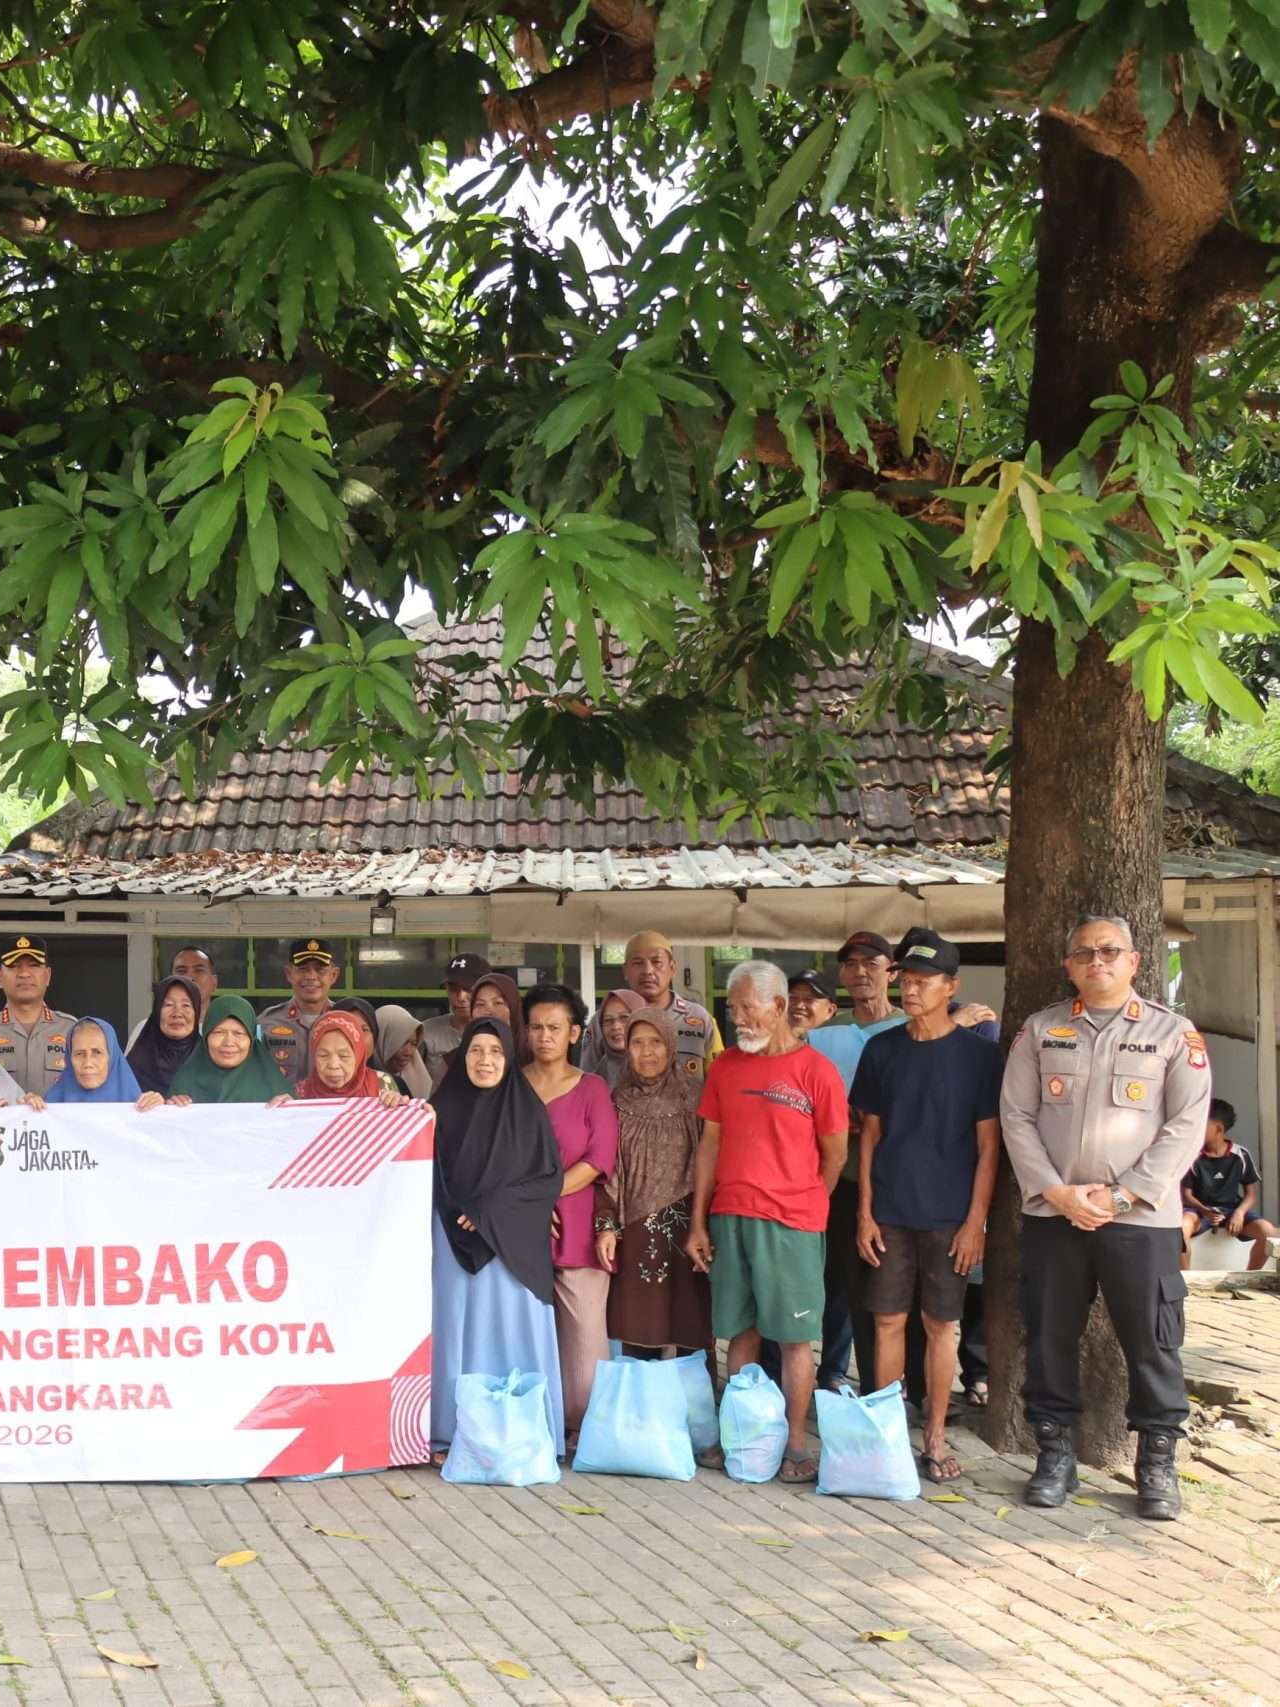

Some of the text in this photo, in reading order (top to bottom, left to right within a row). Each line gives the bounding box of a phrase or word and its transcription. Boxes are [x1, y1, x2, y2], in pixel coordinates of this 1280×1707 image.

[1119, 1043, 1158, 1054] POLRI
[8, 1127, 50, 1152] JAGA
[219, 1322, 336, 1357] KOTA
